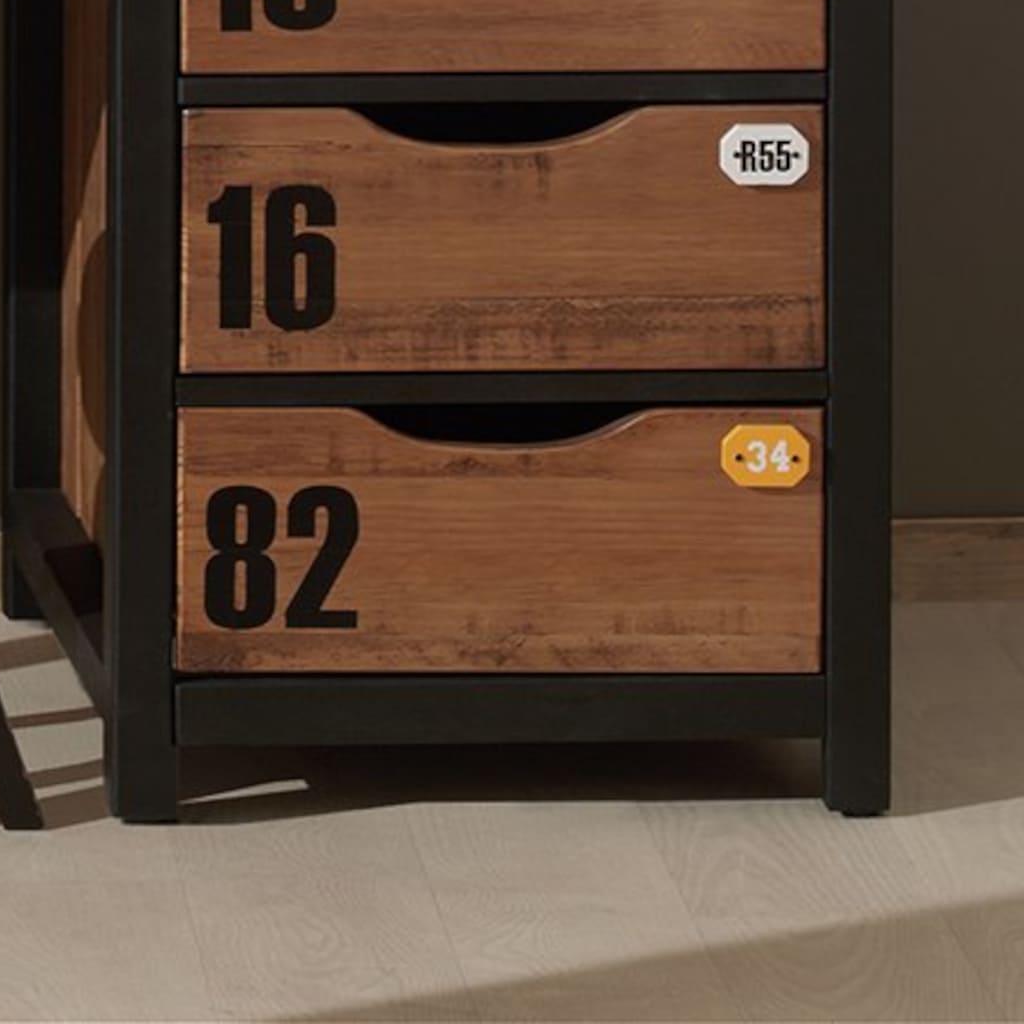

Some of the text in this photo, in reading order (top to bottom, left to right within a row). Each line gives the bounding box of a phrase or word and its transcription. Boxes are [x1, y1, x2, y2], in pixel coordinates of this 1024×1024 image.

[741, 140, 791, 173] R55
[207, 184, 337, 333] 16
[747, 440, 790, 473] 34
[204, 484, 359, 631] 82
